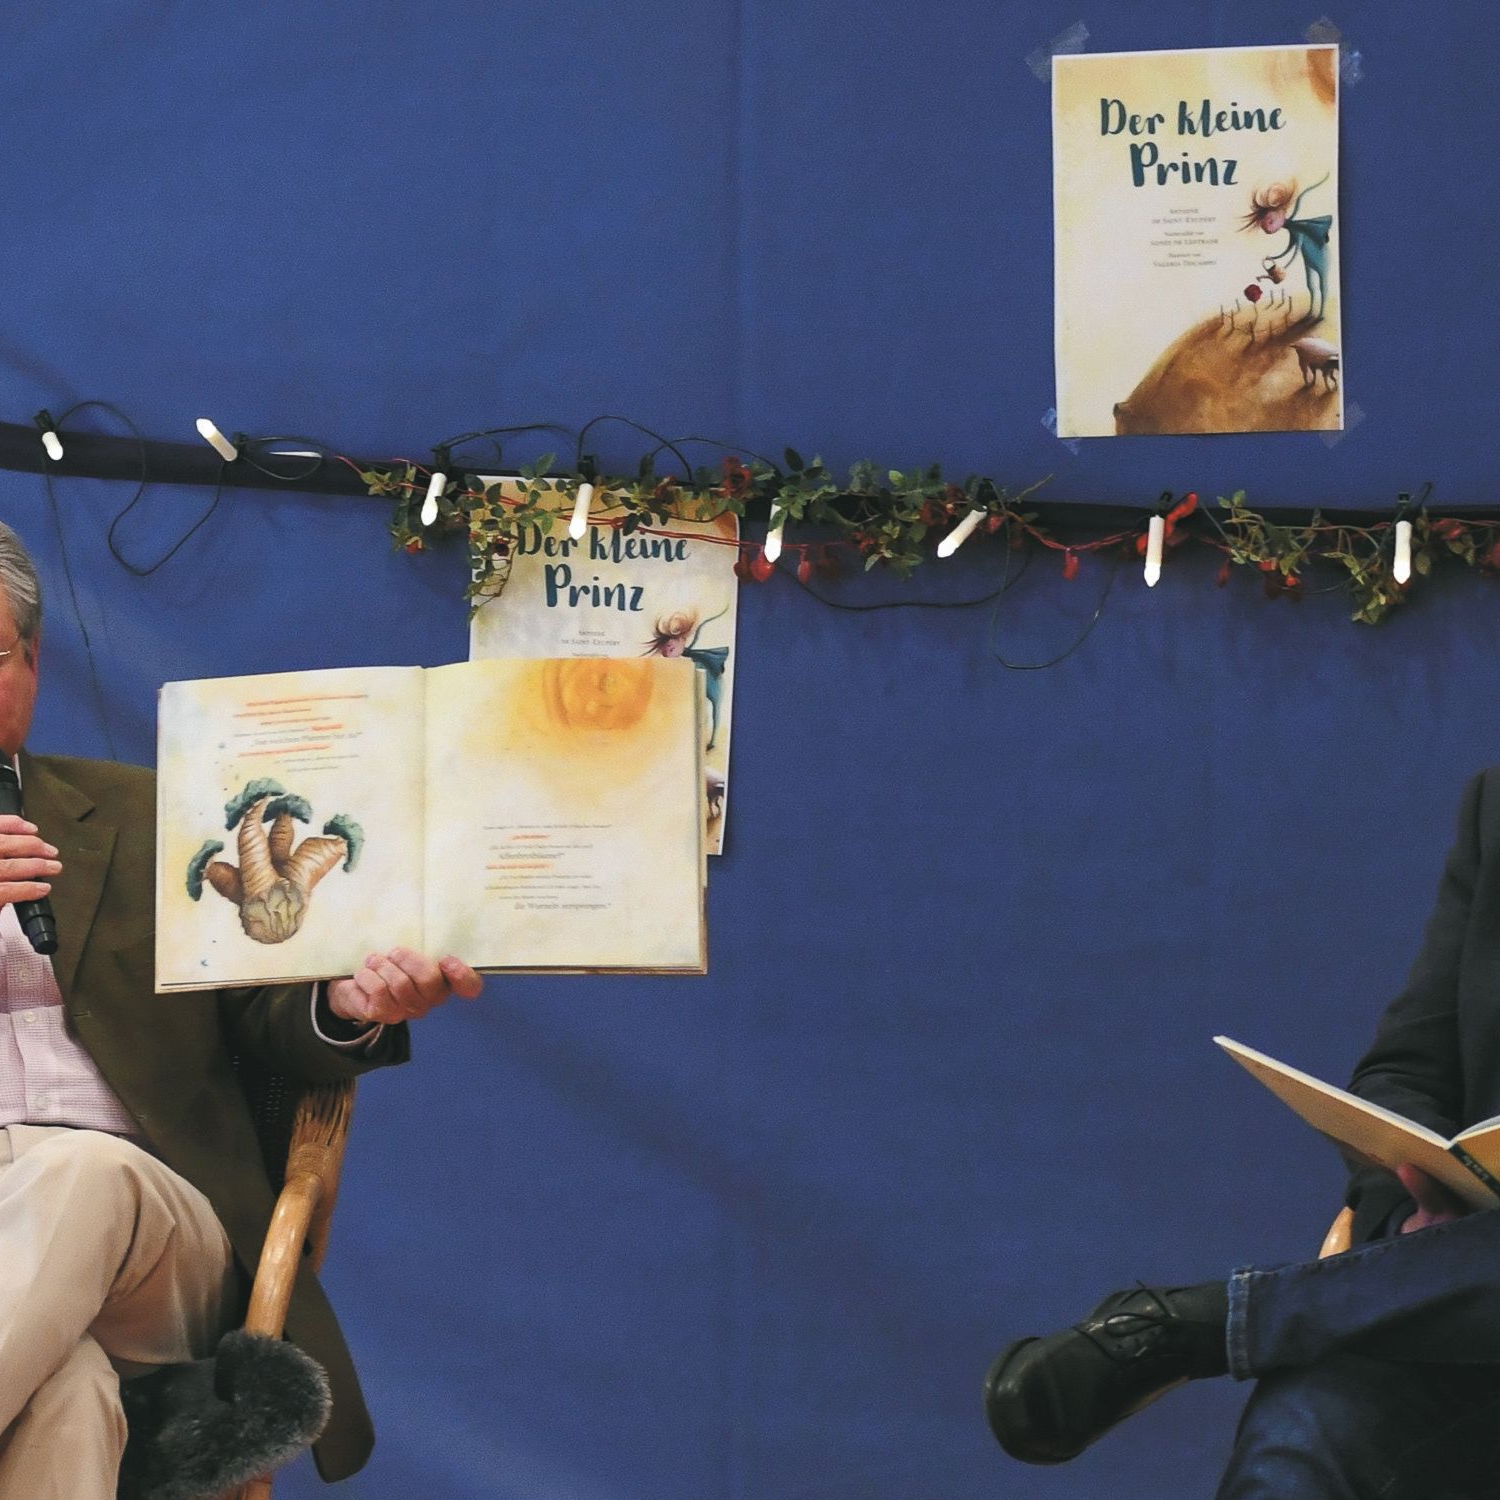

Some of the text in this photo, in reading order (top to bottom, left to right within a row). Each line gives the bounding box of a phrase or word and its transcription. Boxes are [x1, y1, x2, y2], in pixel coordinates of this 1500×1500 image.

[1100, 98, 1286, 138] Der kleine
[1129, 141, 1239, 187] Prinz
[516, 521, 692, 563] Der kleine
[544, 563, 644, 612] Prinz
